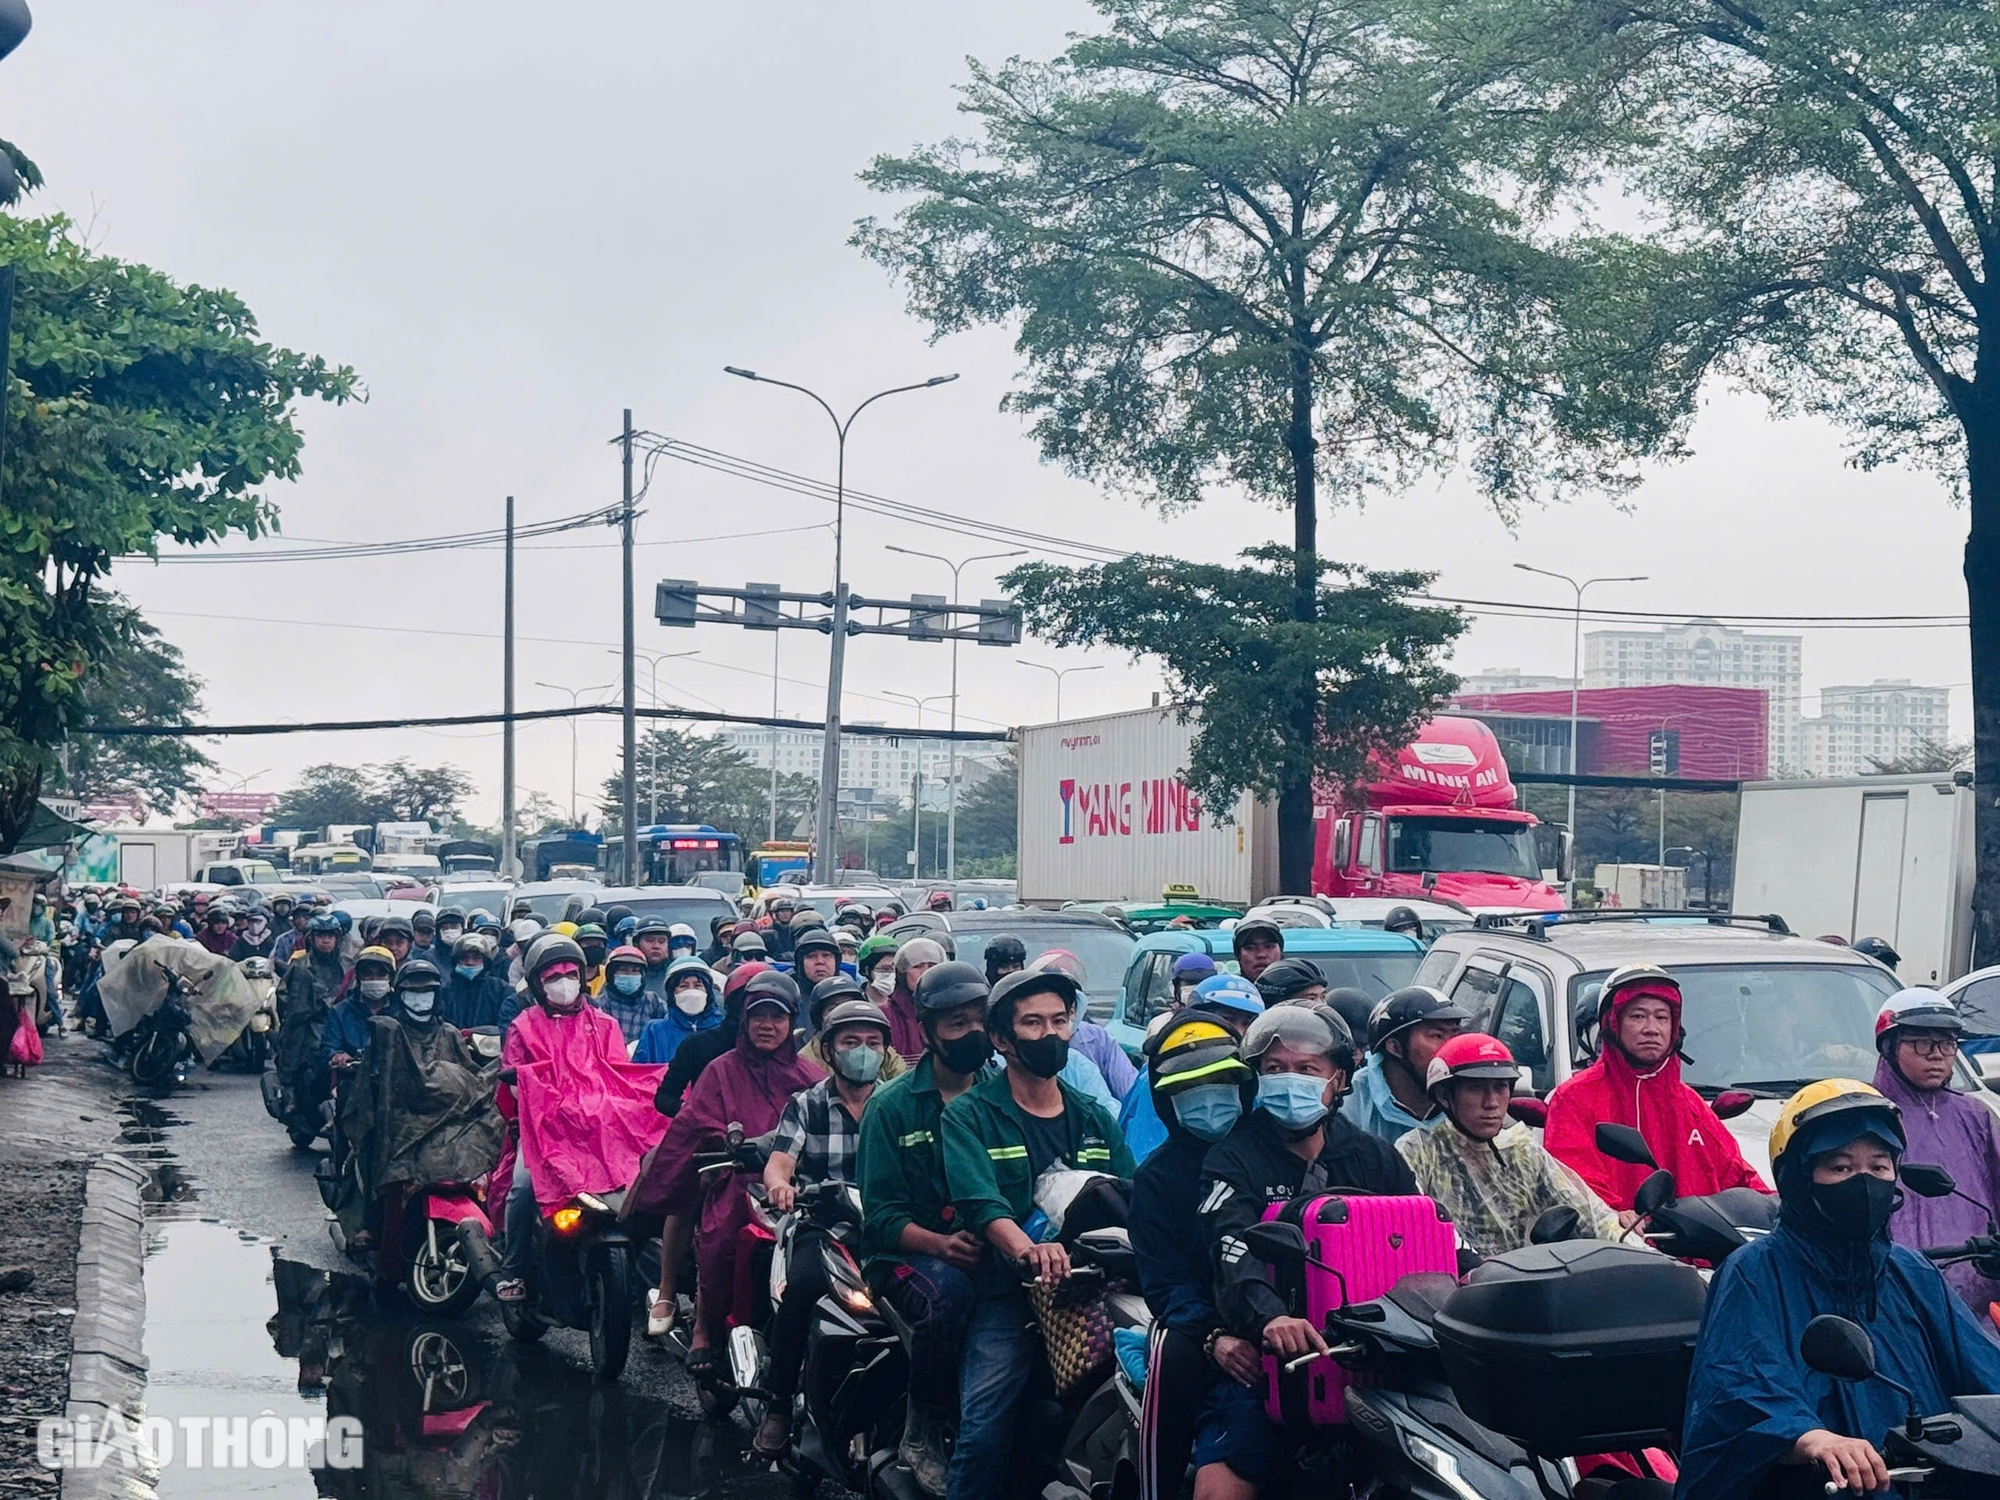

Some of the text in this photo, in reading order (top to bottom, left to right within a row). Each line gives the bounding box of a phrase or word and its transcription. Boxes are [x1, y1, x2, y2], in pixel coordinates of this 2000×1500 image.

[1402, 764, 1499, 788] MINH AN
[1079, 782, 1131, 836] YANG
